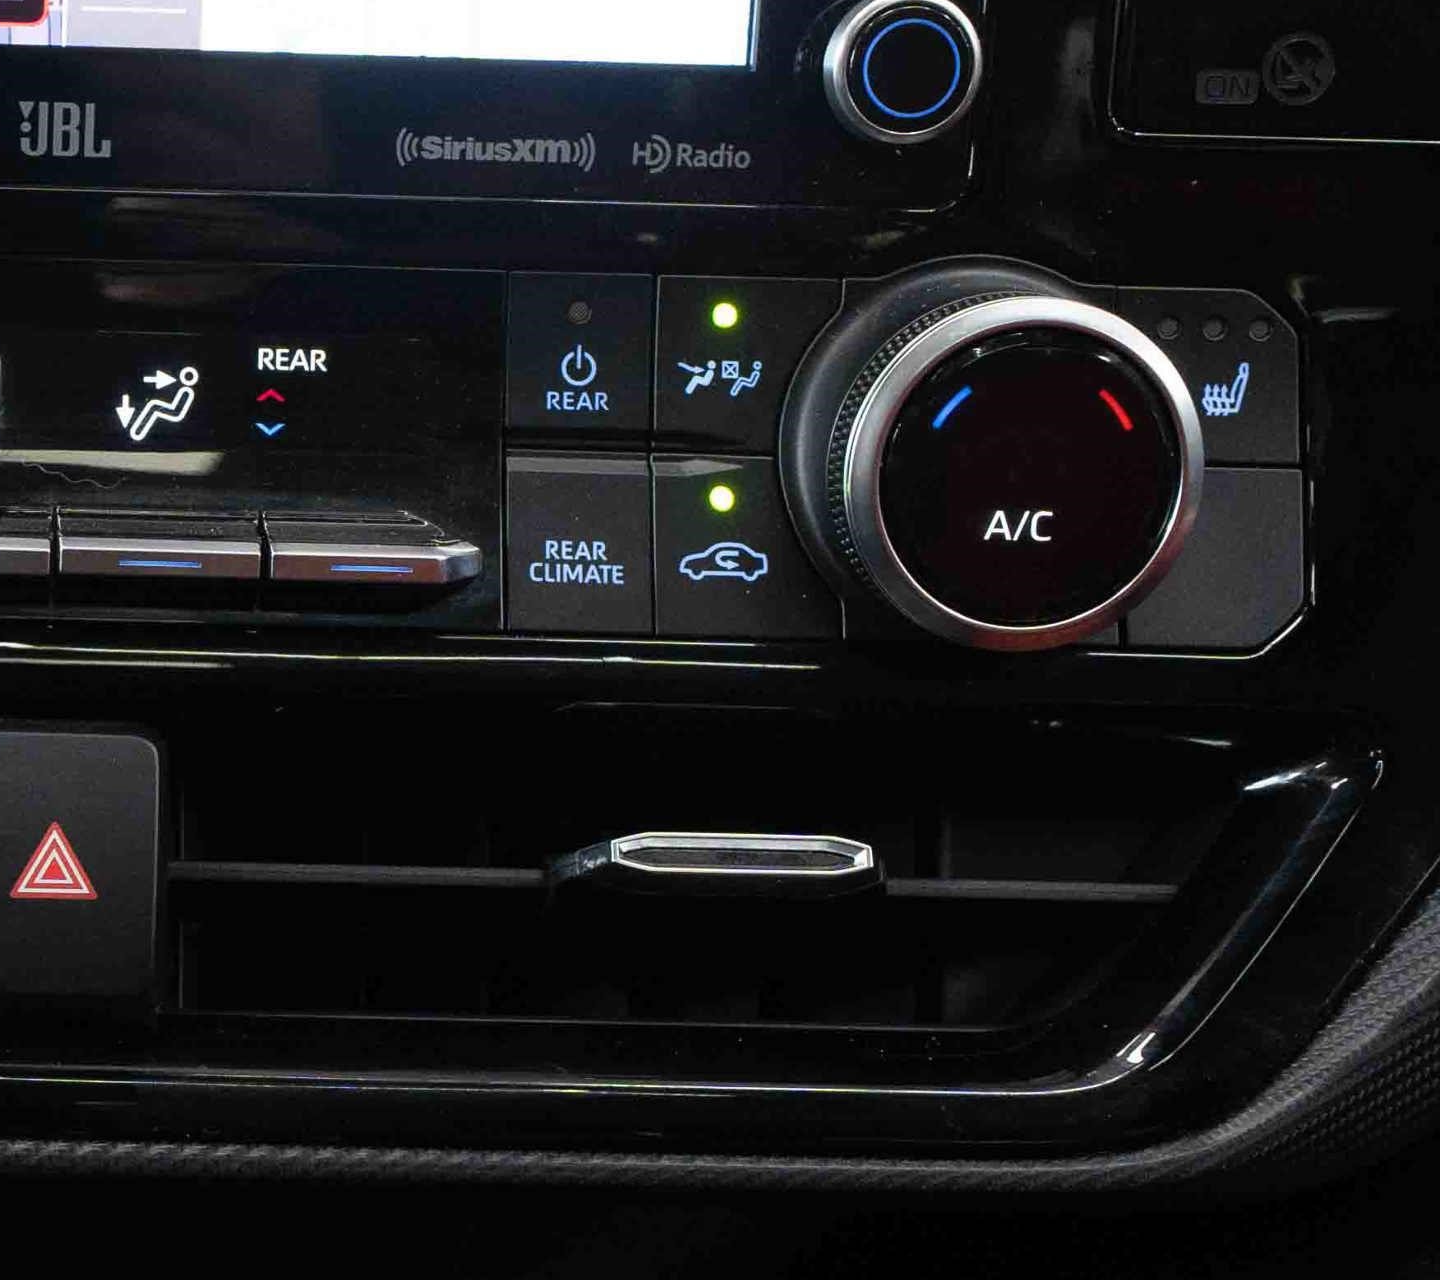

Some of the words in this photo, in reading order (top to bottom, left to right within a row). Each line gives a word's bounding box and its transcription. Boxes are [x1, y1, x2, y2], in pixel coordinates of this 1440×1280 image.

[18, 100, 112, 159] JBL
[675, 142, 751, 169] Radio
[257, 347, 328, 372] REAR
[546, 390, 609, 411] REAR
[983, 509, 1054, 542] A/C
[545, 539, 607, 561] REAR
[529, 562, 625, 585] CLIMATE
